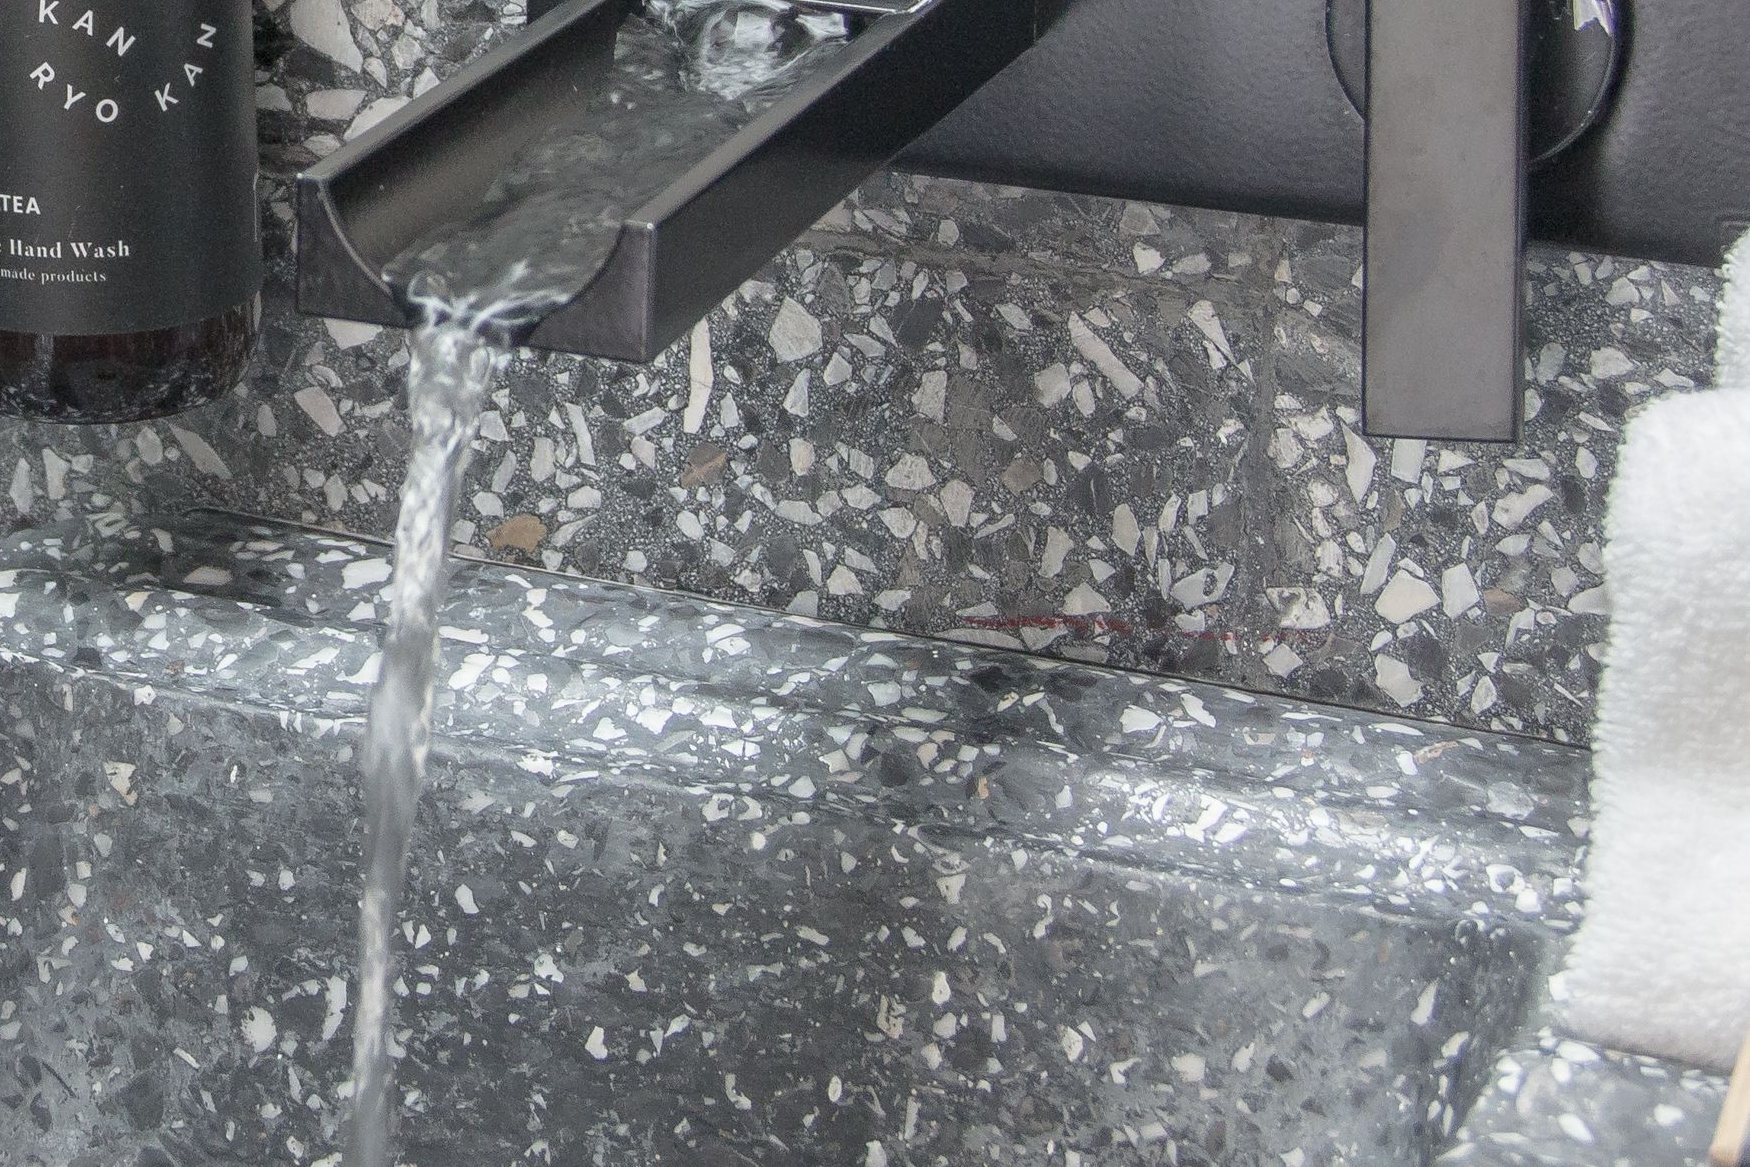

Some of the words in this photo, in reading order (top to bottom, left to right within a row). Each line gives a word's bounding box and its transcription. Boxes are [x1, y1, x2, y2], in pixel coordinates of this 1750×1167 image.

[29, 61, 120, 124] RYO
[153, 22, 219, 113] KAN
[0, 193, 42, 216] TEA
[9, 238, 62, 259] Hand
[70, 240, 131, 259] Wash
[41, 271, 107, 285] products
